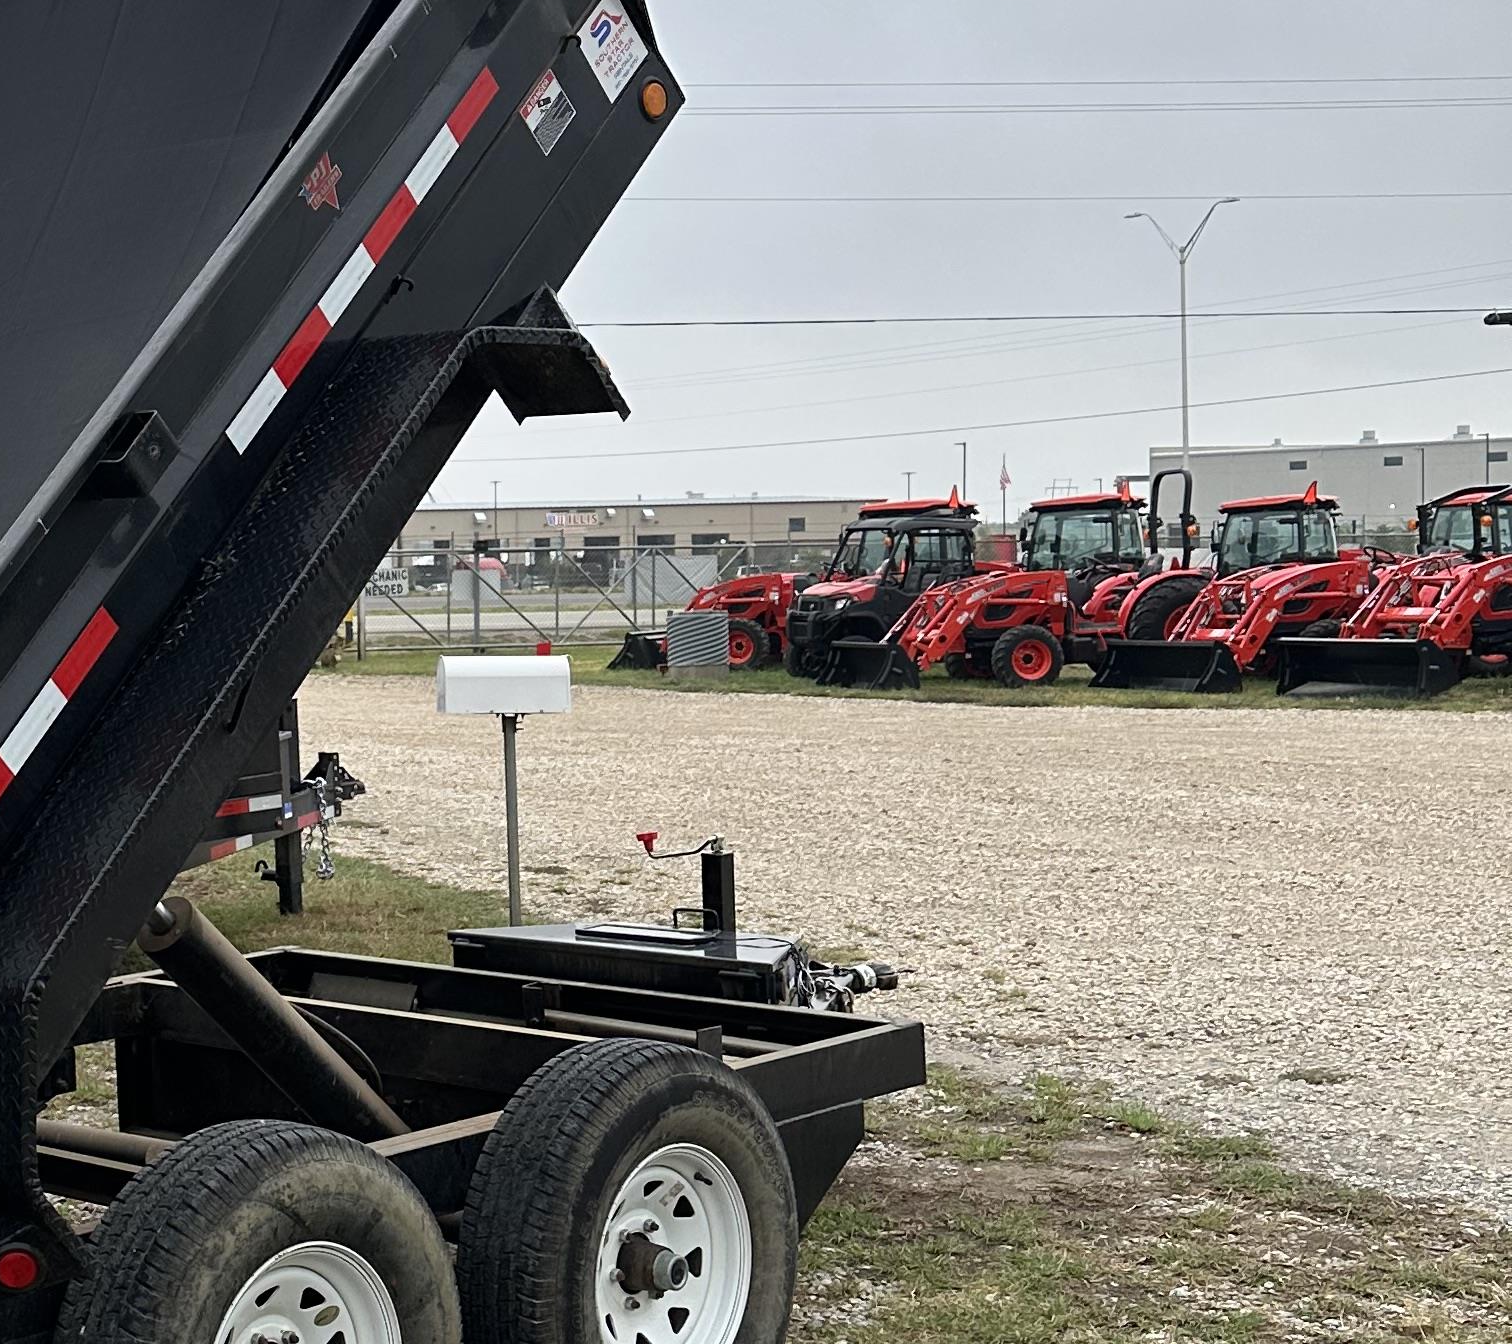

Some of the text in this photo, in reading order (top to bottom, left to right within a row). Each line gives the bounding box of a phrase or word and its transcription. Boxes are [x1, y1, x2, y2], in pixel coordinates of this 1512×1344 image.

[594, 22, 629, 68] SOUTHERN
[604, 37, 635, 76] TRACTOR
[607, 40, 625, 63] STAR
[372, 569, 408, 582] CHANIC
[365, 584, 403, 597] NEEDED
